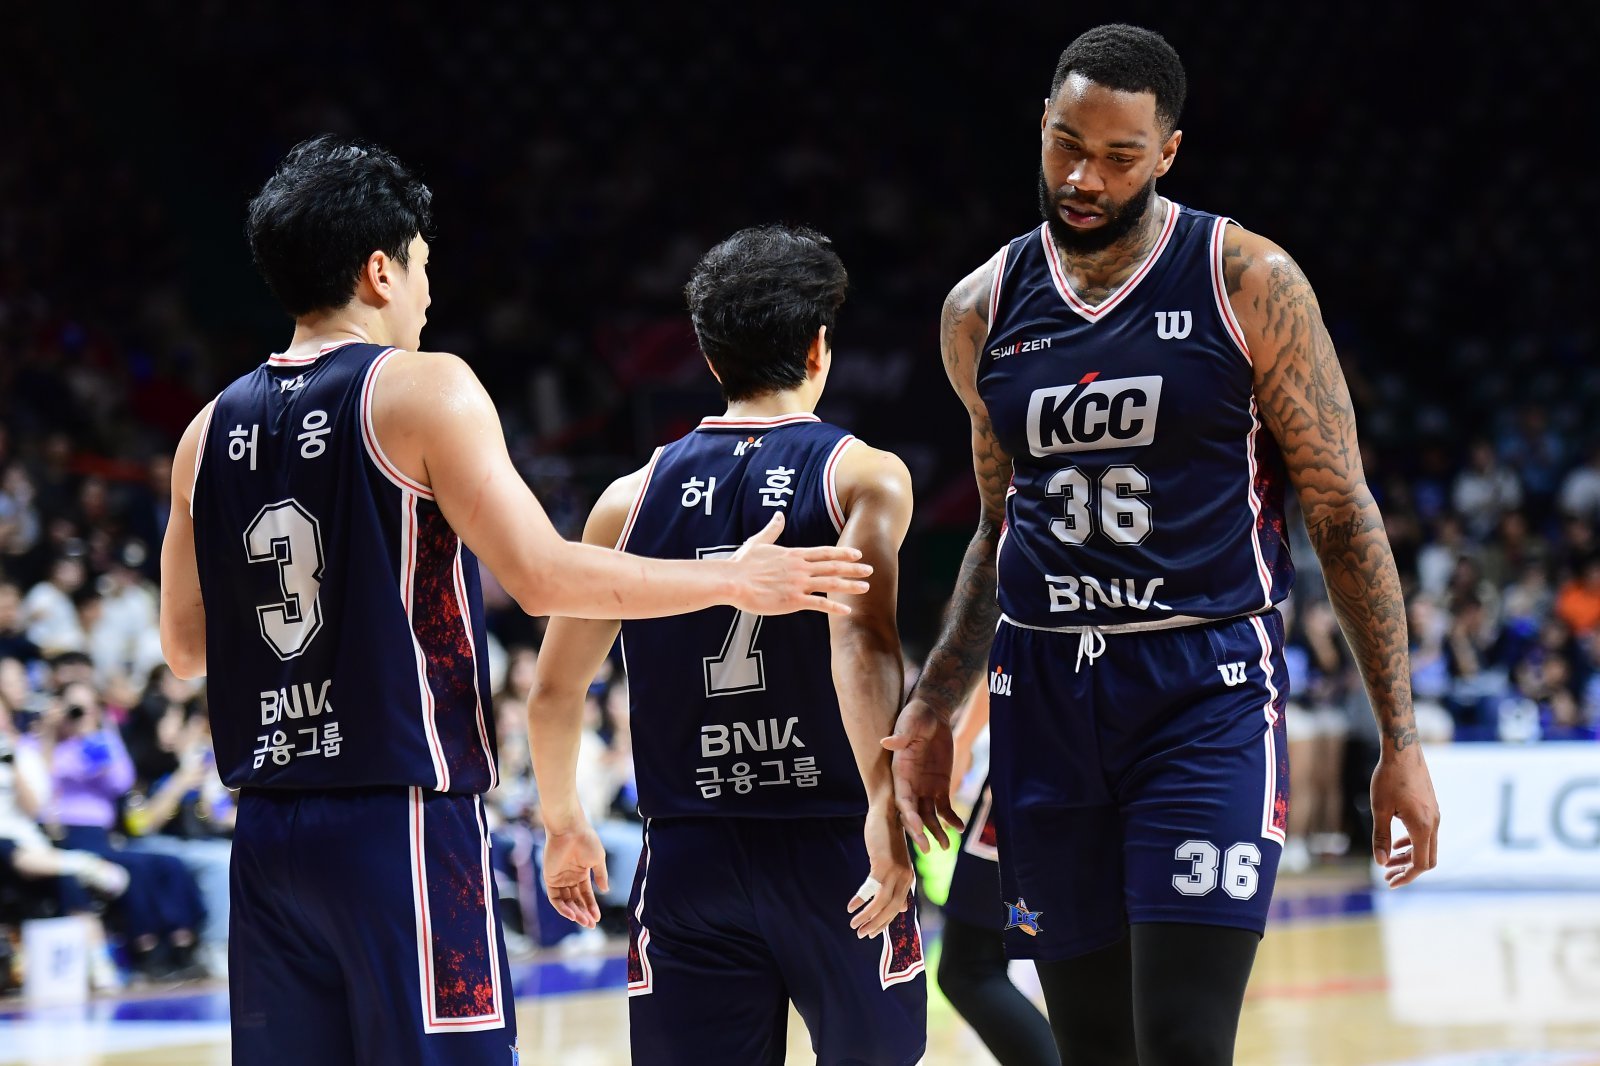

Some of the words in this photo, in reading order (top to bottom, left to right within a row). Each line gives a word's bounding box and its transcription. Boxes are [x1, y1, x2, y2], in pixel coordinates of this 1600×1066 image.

[1040, 372, 1147, 448] KCC
[229, 424, 259, 471] 허
[298, 409, 332, 459] 웅
[681, 476, 717, 516] 허
[759, 465, 795, 507] 훈
[1045, 463, 1154, 547] 36
[243, 498, 326, 661] 3
[1045, 574, 1173, 612] BNK
[260, 680, 333, 726] BNK
[253, 721, 343, 770] 금융그룹
[701, 716, 806, 758] BNK
[696, 755, 821, 799] 금융그룹
[1172, 839, 1262, 900] 36
